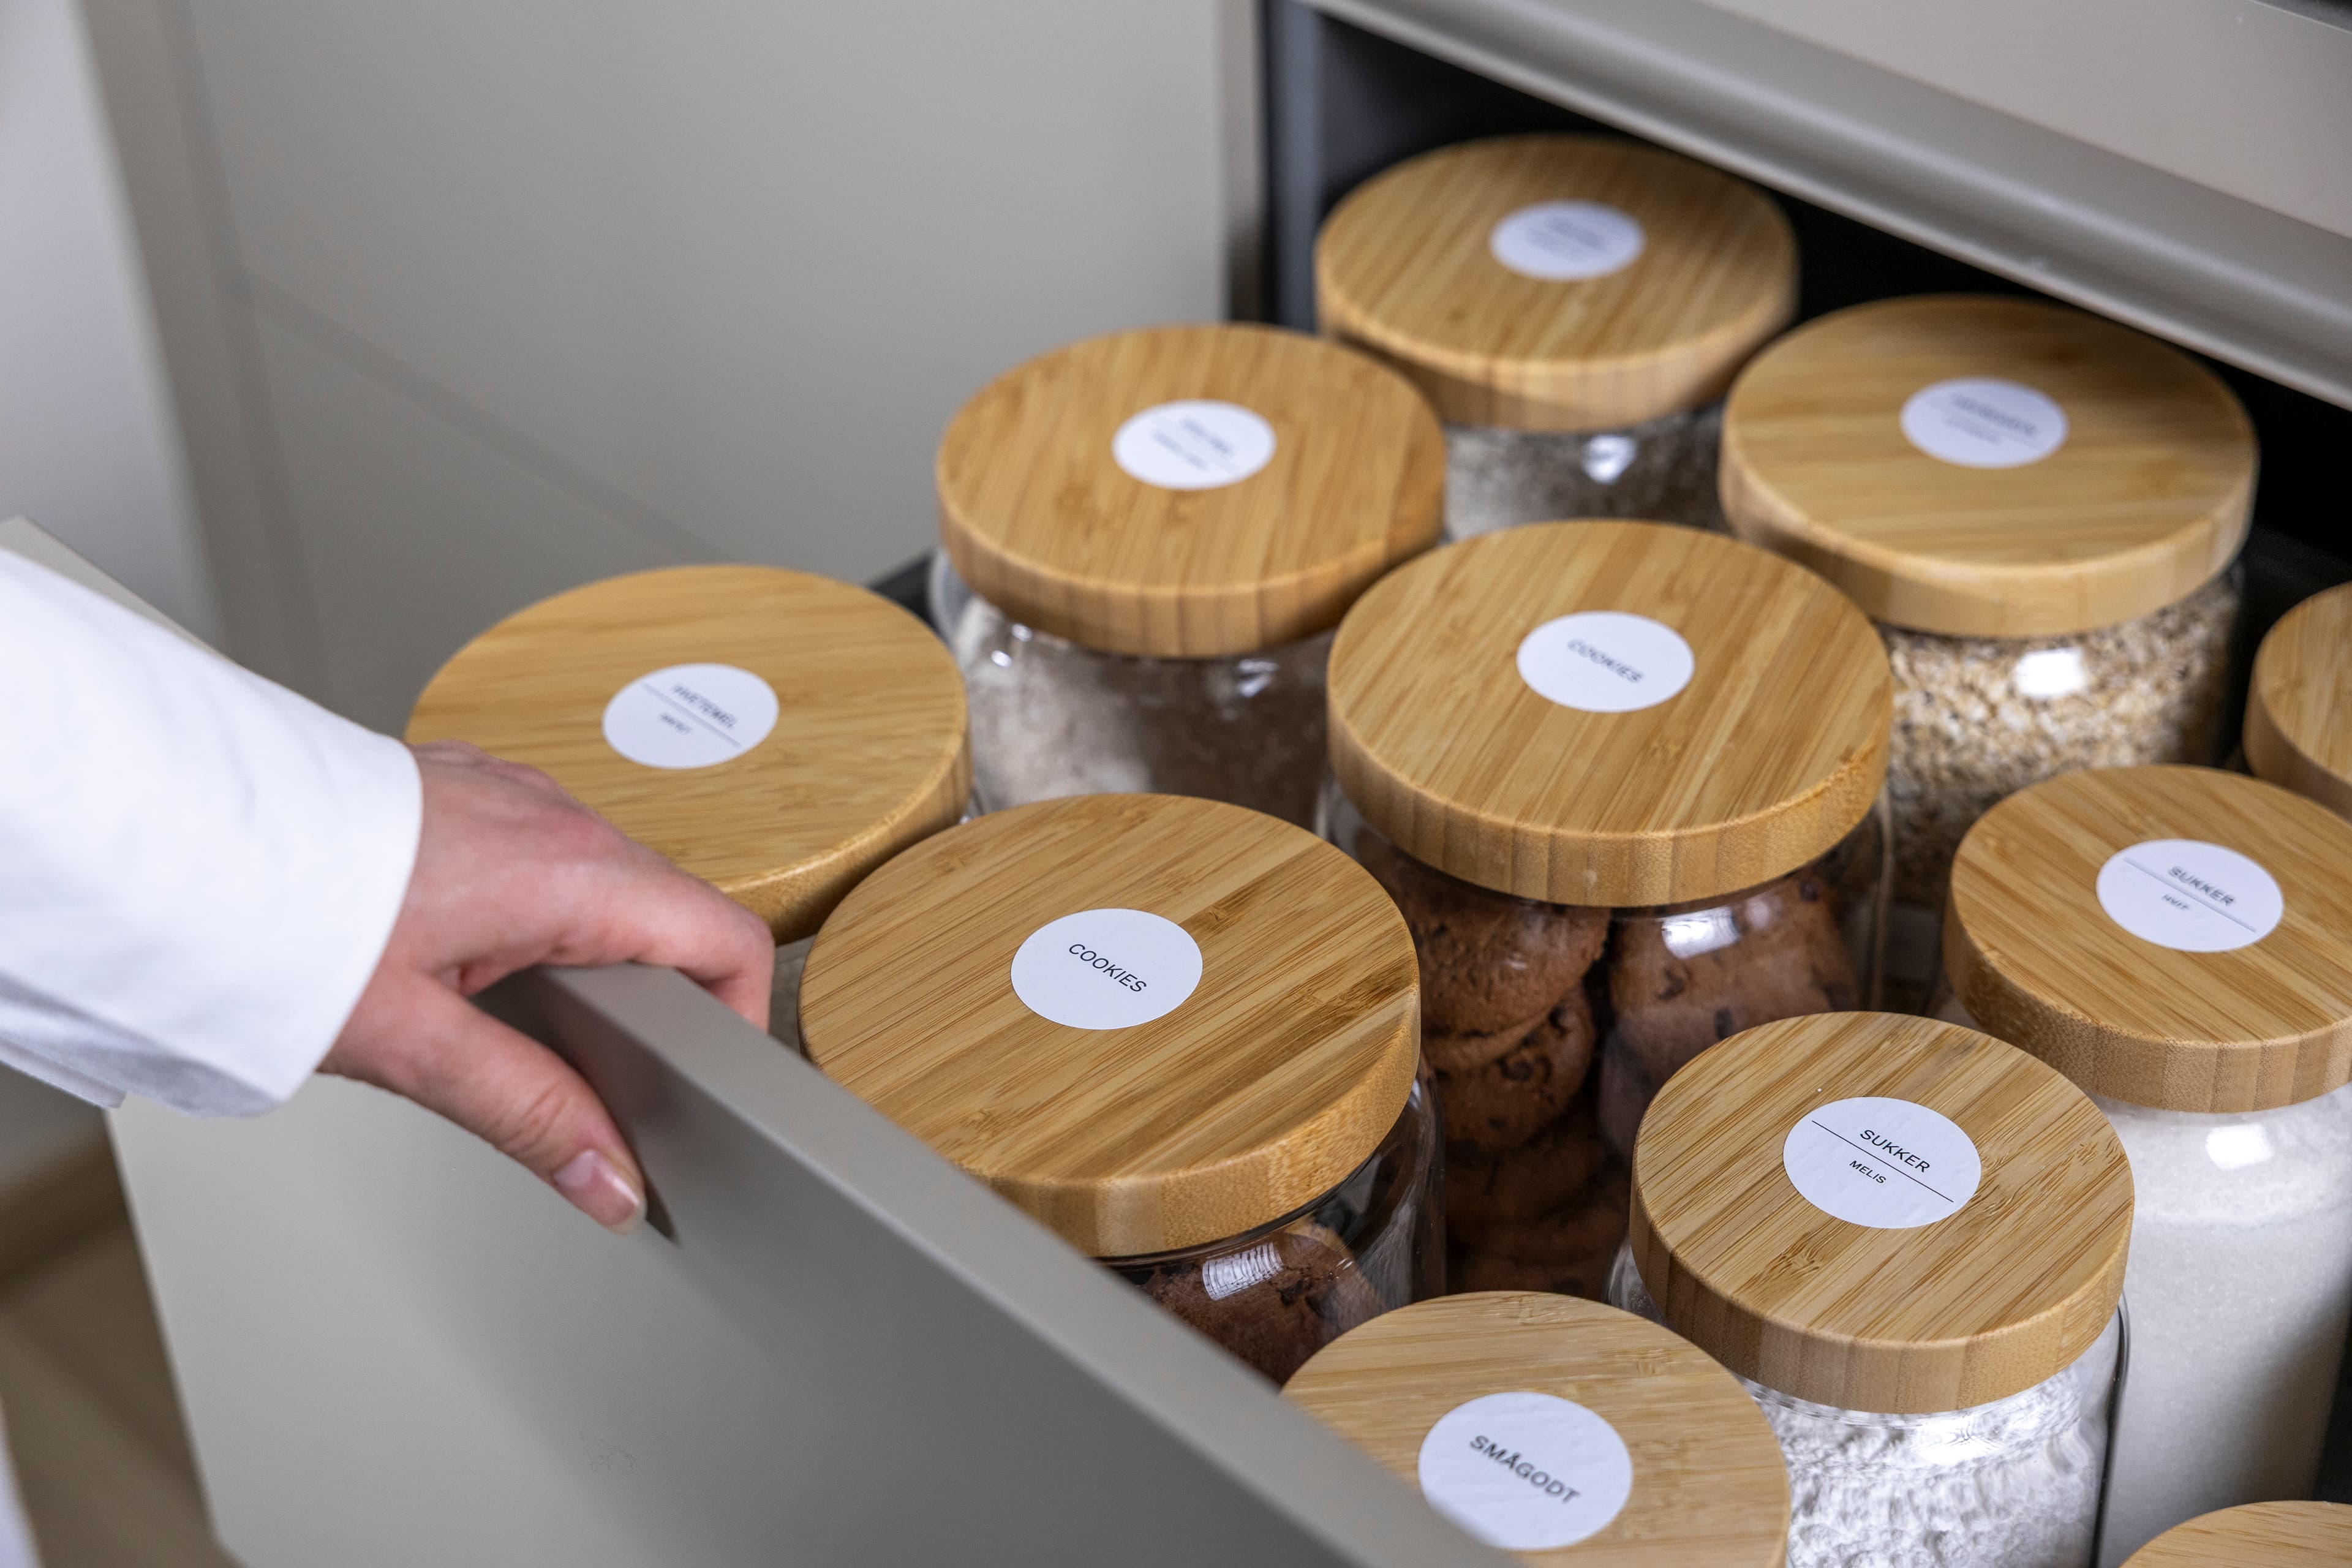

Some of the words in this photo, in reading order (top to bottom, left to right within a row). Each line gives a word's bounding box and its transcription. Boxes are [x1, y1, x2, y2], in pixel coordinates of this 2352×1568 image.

[1567, 639, 1644, 683] COOKIES
[2168, 866, 2236, 905] SUKKER
[1069, 944, 1147, 992] COOKIES
[1849, 1160, 1887, 1184] MELIS
[1860, 1129, 1931, 1172] SUKKER
[1469, 1435, 1581, 1504] SMÅGODT
